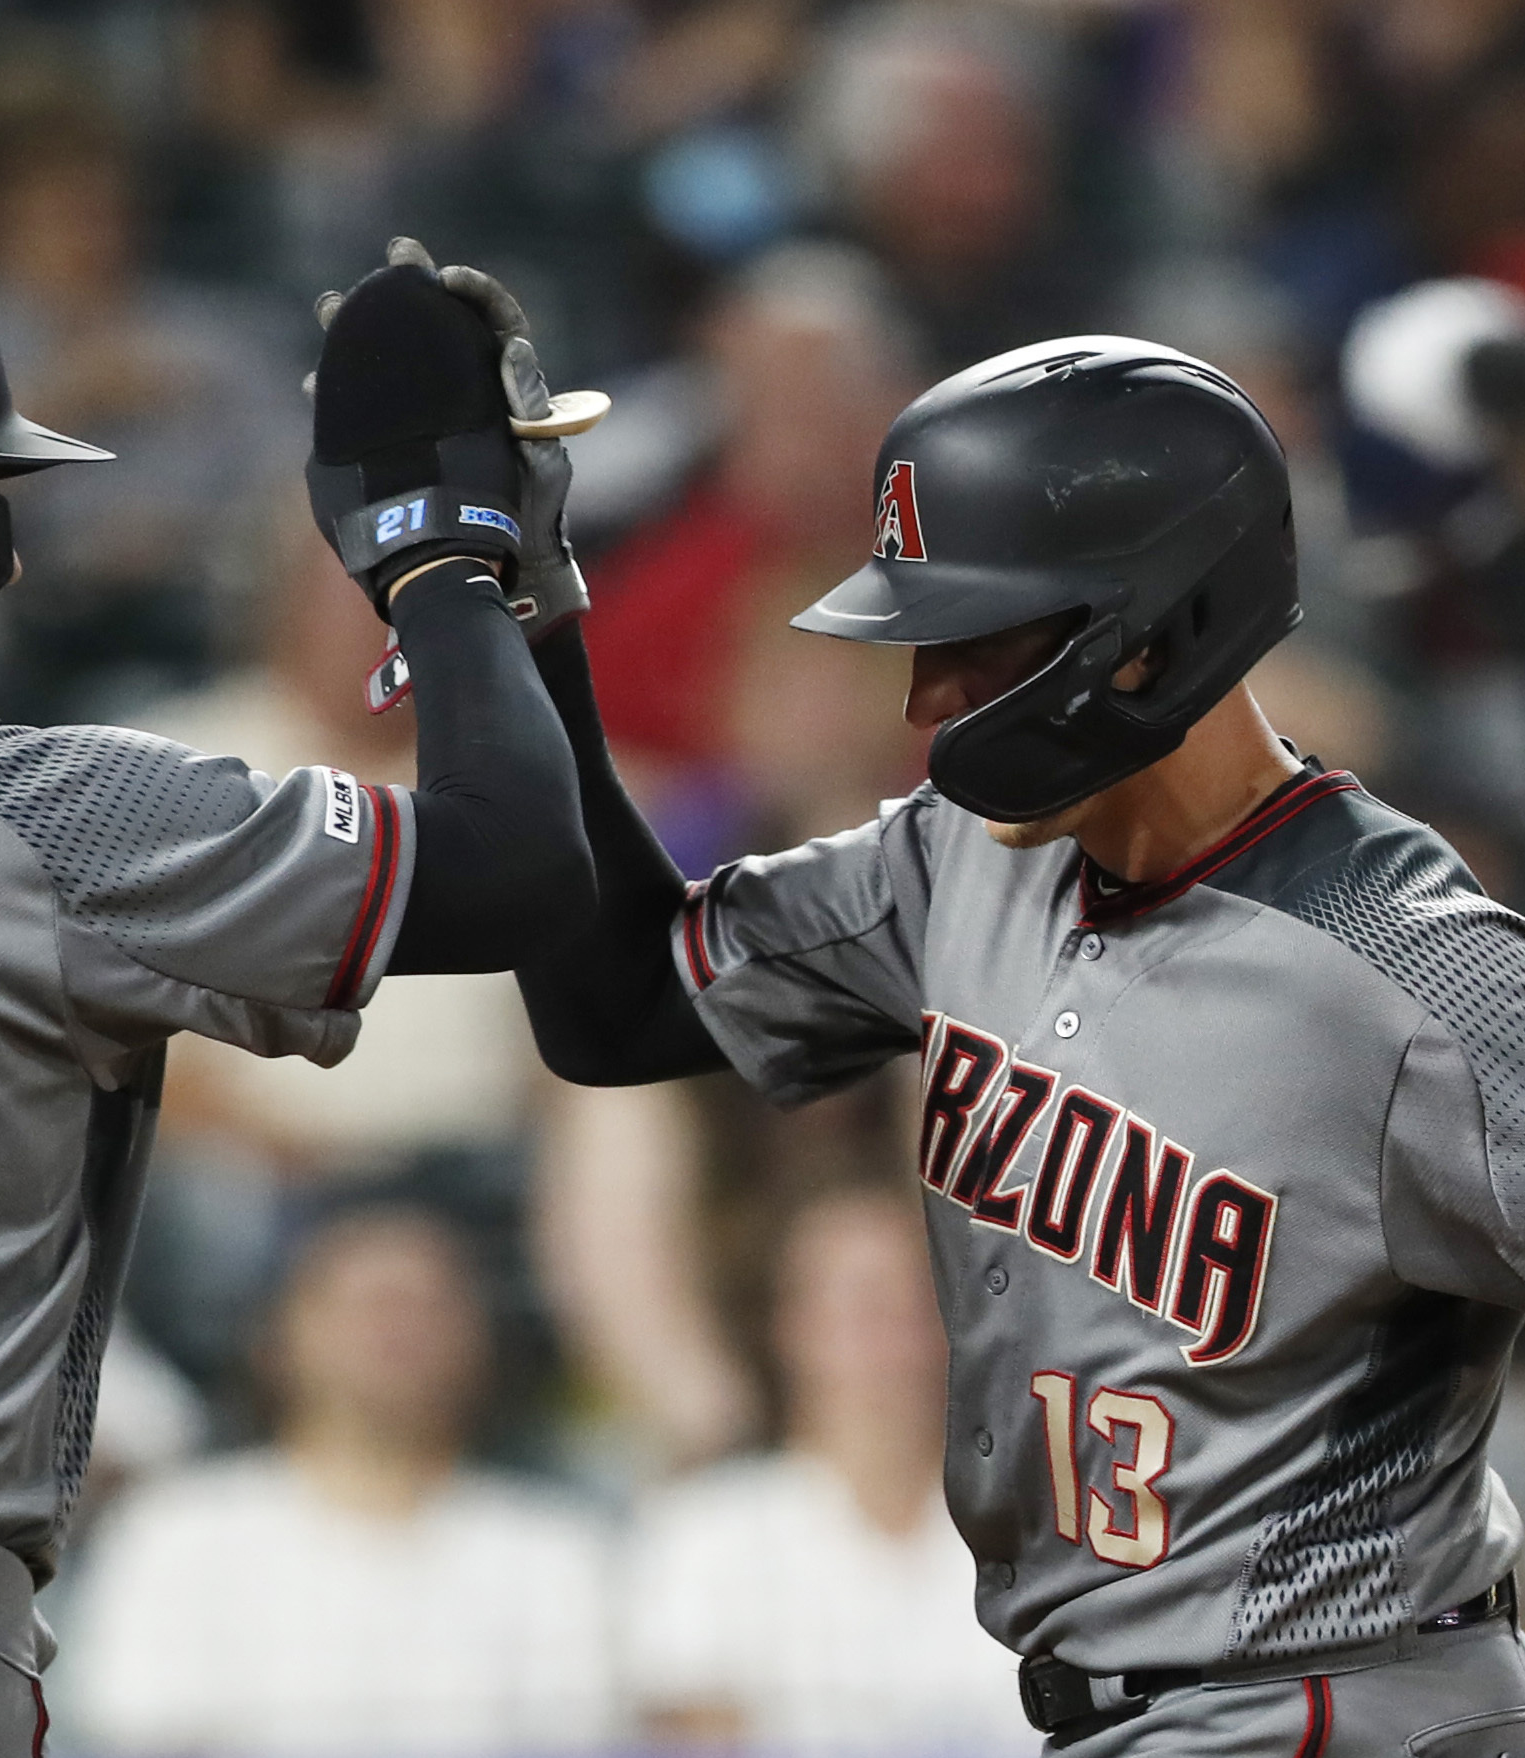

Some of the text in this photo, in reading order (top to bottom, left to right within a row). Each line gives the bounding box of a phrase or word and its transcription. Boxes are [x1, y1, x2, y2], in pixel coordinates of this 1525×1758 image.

[376, 498, 427, 544] 21
[333, 792, 353, 835] MLB
[921, 1008, 1279, 1368] RIZONA
[1029, 1369, 1175, 1570] 13
